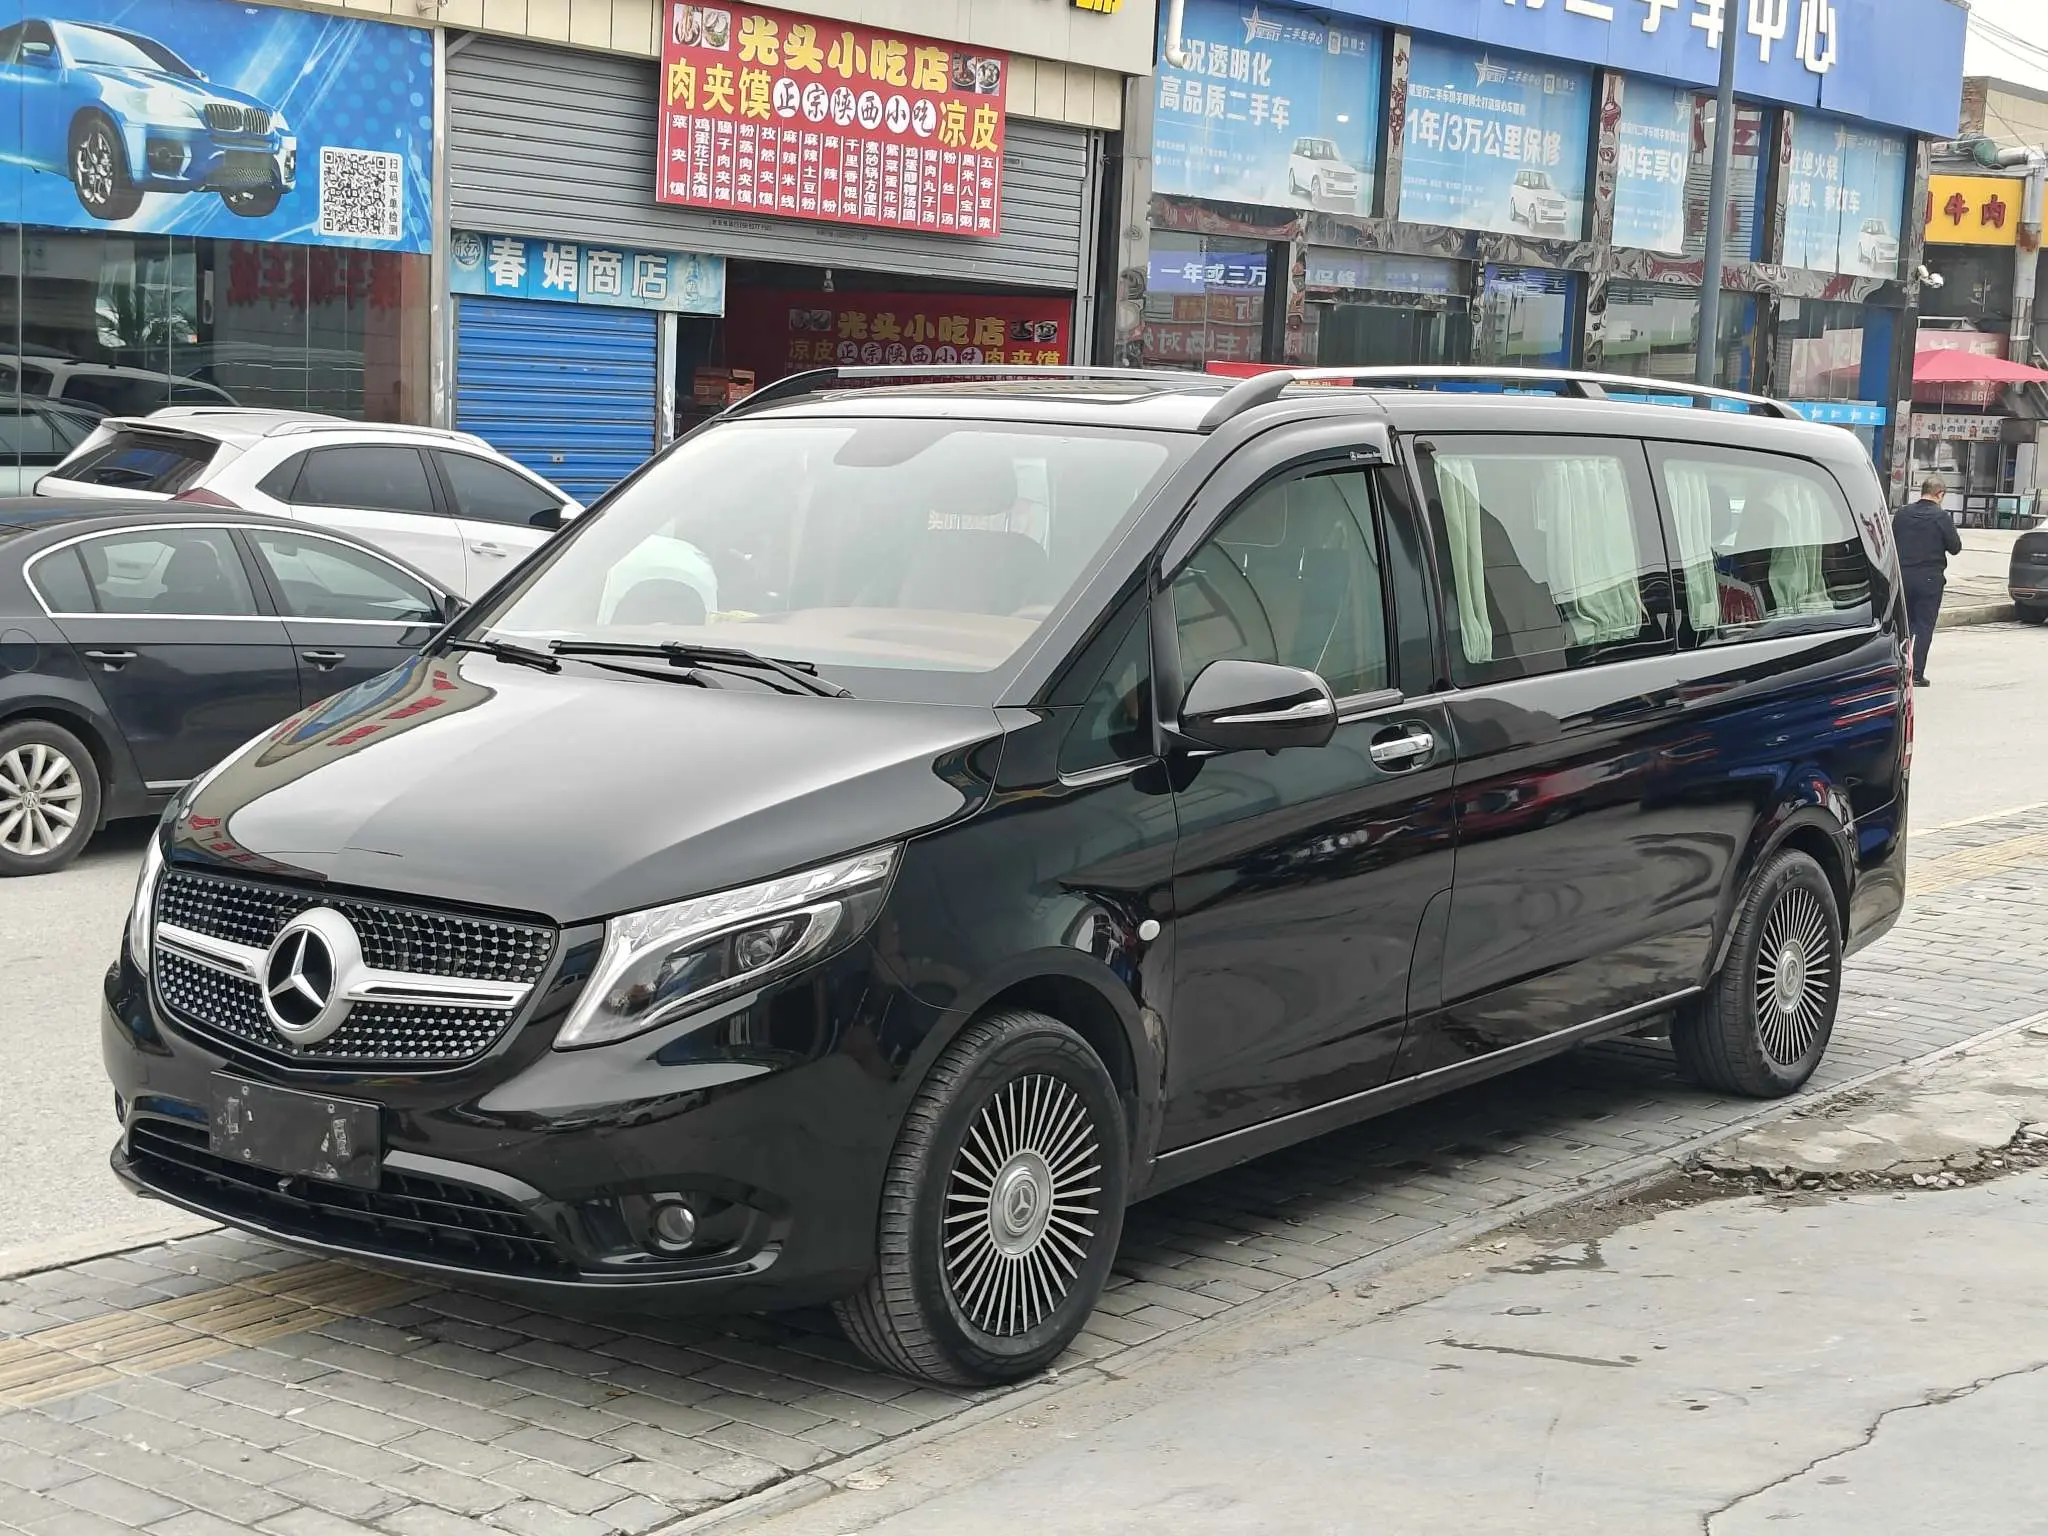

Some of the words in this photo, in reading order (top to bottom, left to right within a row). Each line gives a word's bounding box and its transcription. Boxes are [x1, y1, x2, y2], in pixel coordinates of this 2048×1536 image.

[737, 15, 950, 94] 光头小吃店
[1163, 35, 1272, 87] 况透明化
[667, 57, 774, 121] 肉夹馍
[775, 79, 936, 135] 正宗陕西小吃
[937, 99, 999, 153] 凉皮
[1160, 76, 1291, 134] 高品质二手车
[1407, 108, 1561, 166] 1年/3万公里保修
[669, 114, 688, 196] 菜夹馍
[736, 123, 755, 204] 粉蒸肉夹馍
[758, 127, 776, 206] 孜然夹馍
[780, 130, 798, 209] 麻辣米线
[801, 133, 818, 211] 麻辣土豆粉
[822, 135, 839, 213] 麻辣粉
[843, 138, 859, 215] 千里香馄饨
[883, 143, 899, 219] 紫菜蛋花汤
[922, 149, 938, 224] 瘦肉丸子汤
[941, 152, 956, 225] 粉丝汤
[978, 156, 994, 230] 五谷豆浆
[488, 237, 668, 301] 春娟商店
[1160, 263, 1267, 286] 一年或三万
[1305, 267, 1356, 287] 保修
[789, 338, 834, 362] 凉皮
[837, 310, 1006, 346] 光头小吃店
